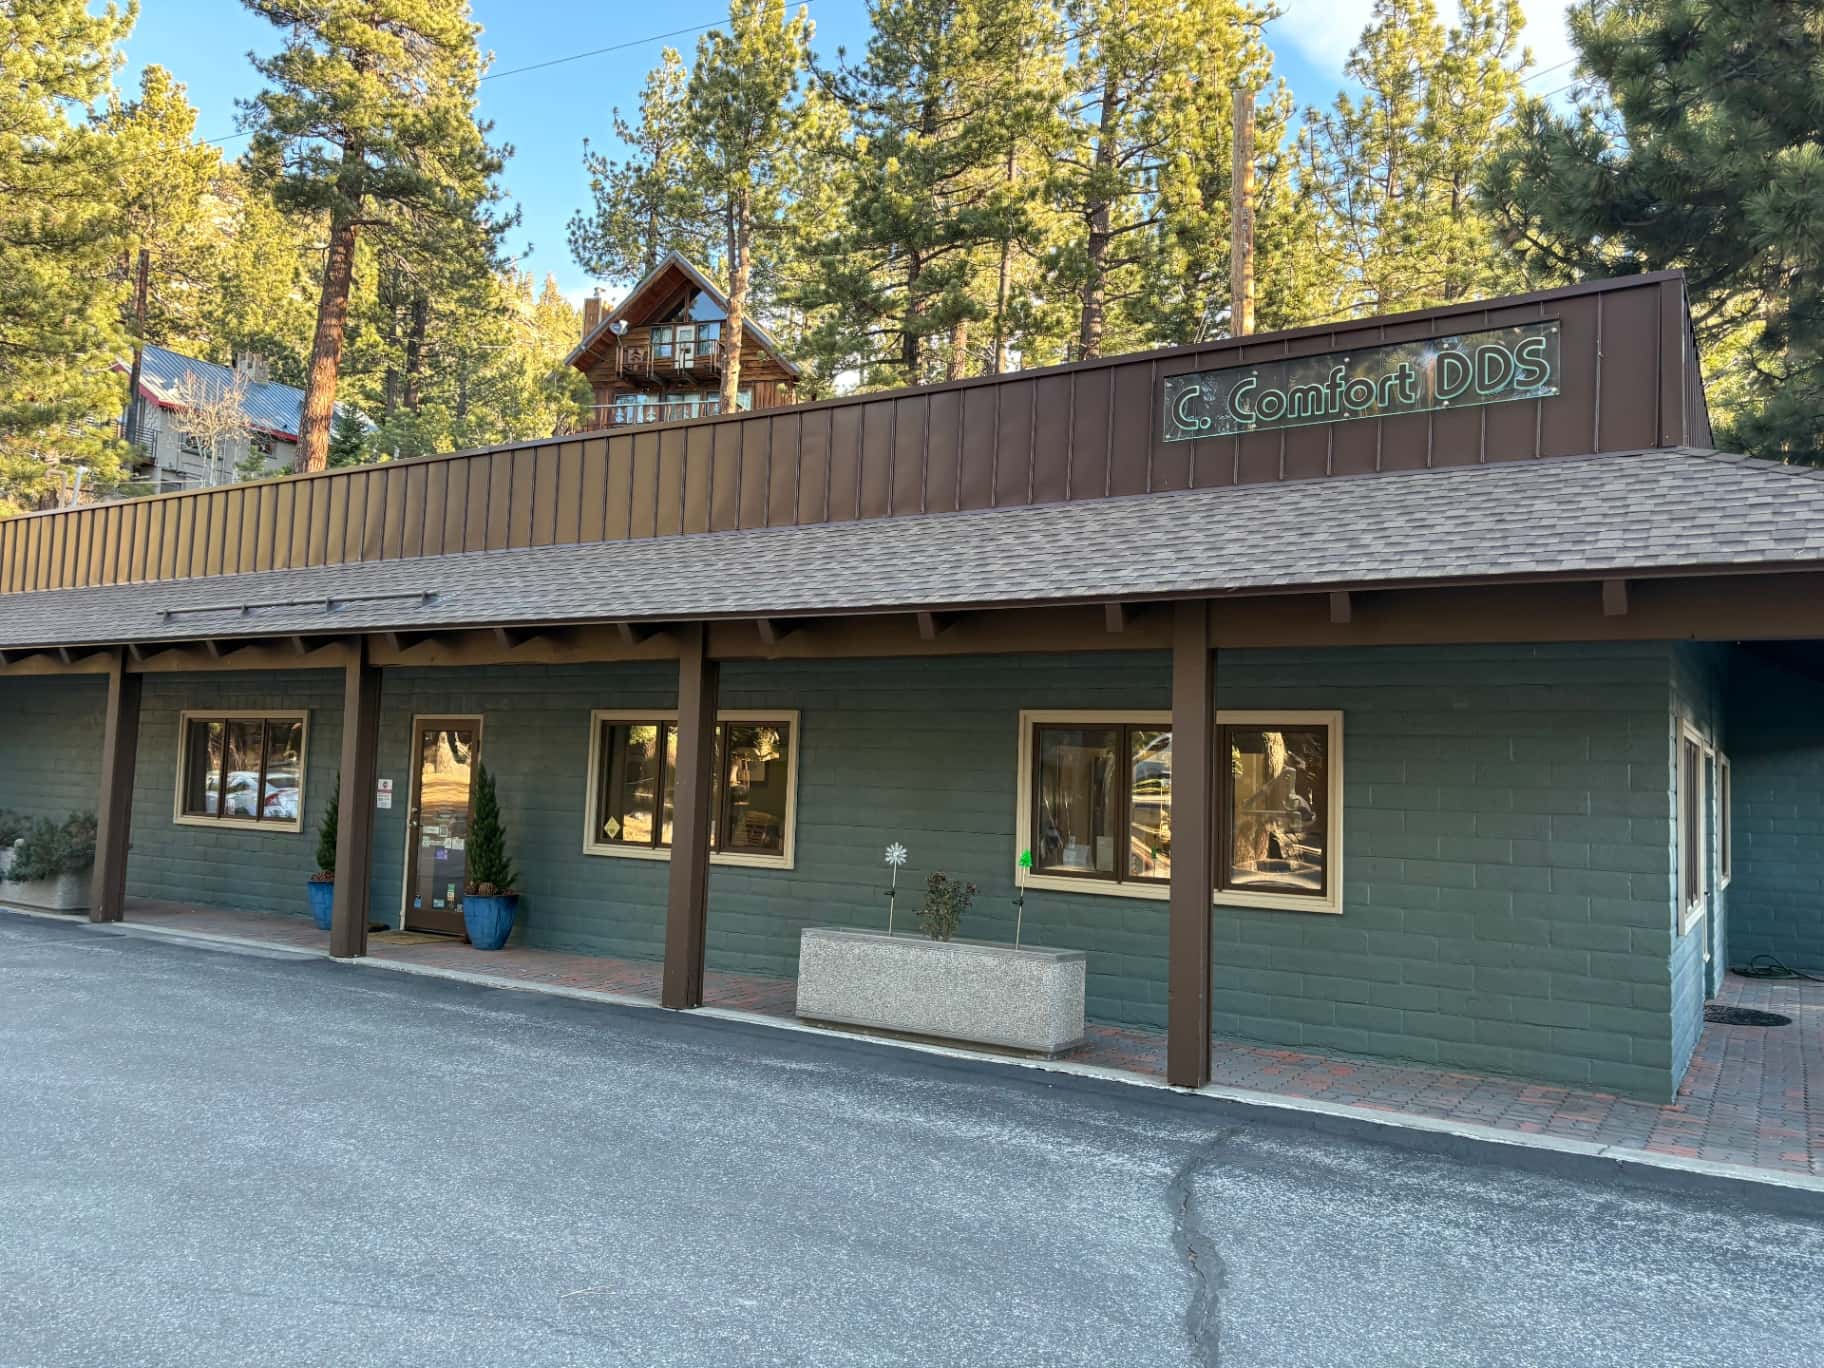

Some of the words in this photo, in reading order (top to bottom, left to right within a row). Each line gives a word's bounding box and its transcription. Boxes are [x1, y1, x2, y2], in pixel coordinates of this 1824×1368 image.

[1171, 385, 1211, 430] C.
[1227, 362, 1417, 424] Comfort
[1434, 336, 1551, 400] DDS
